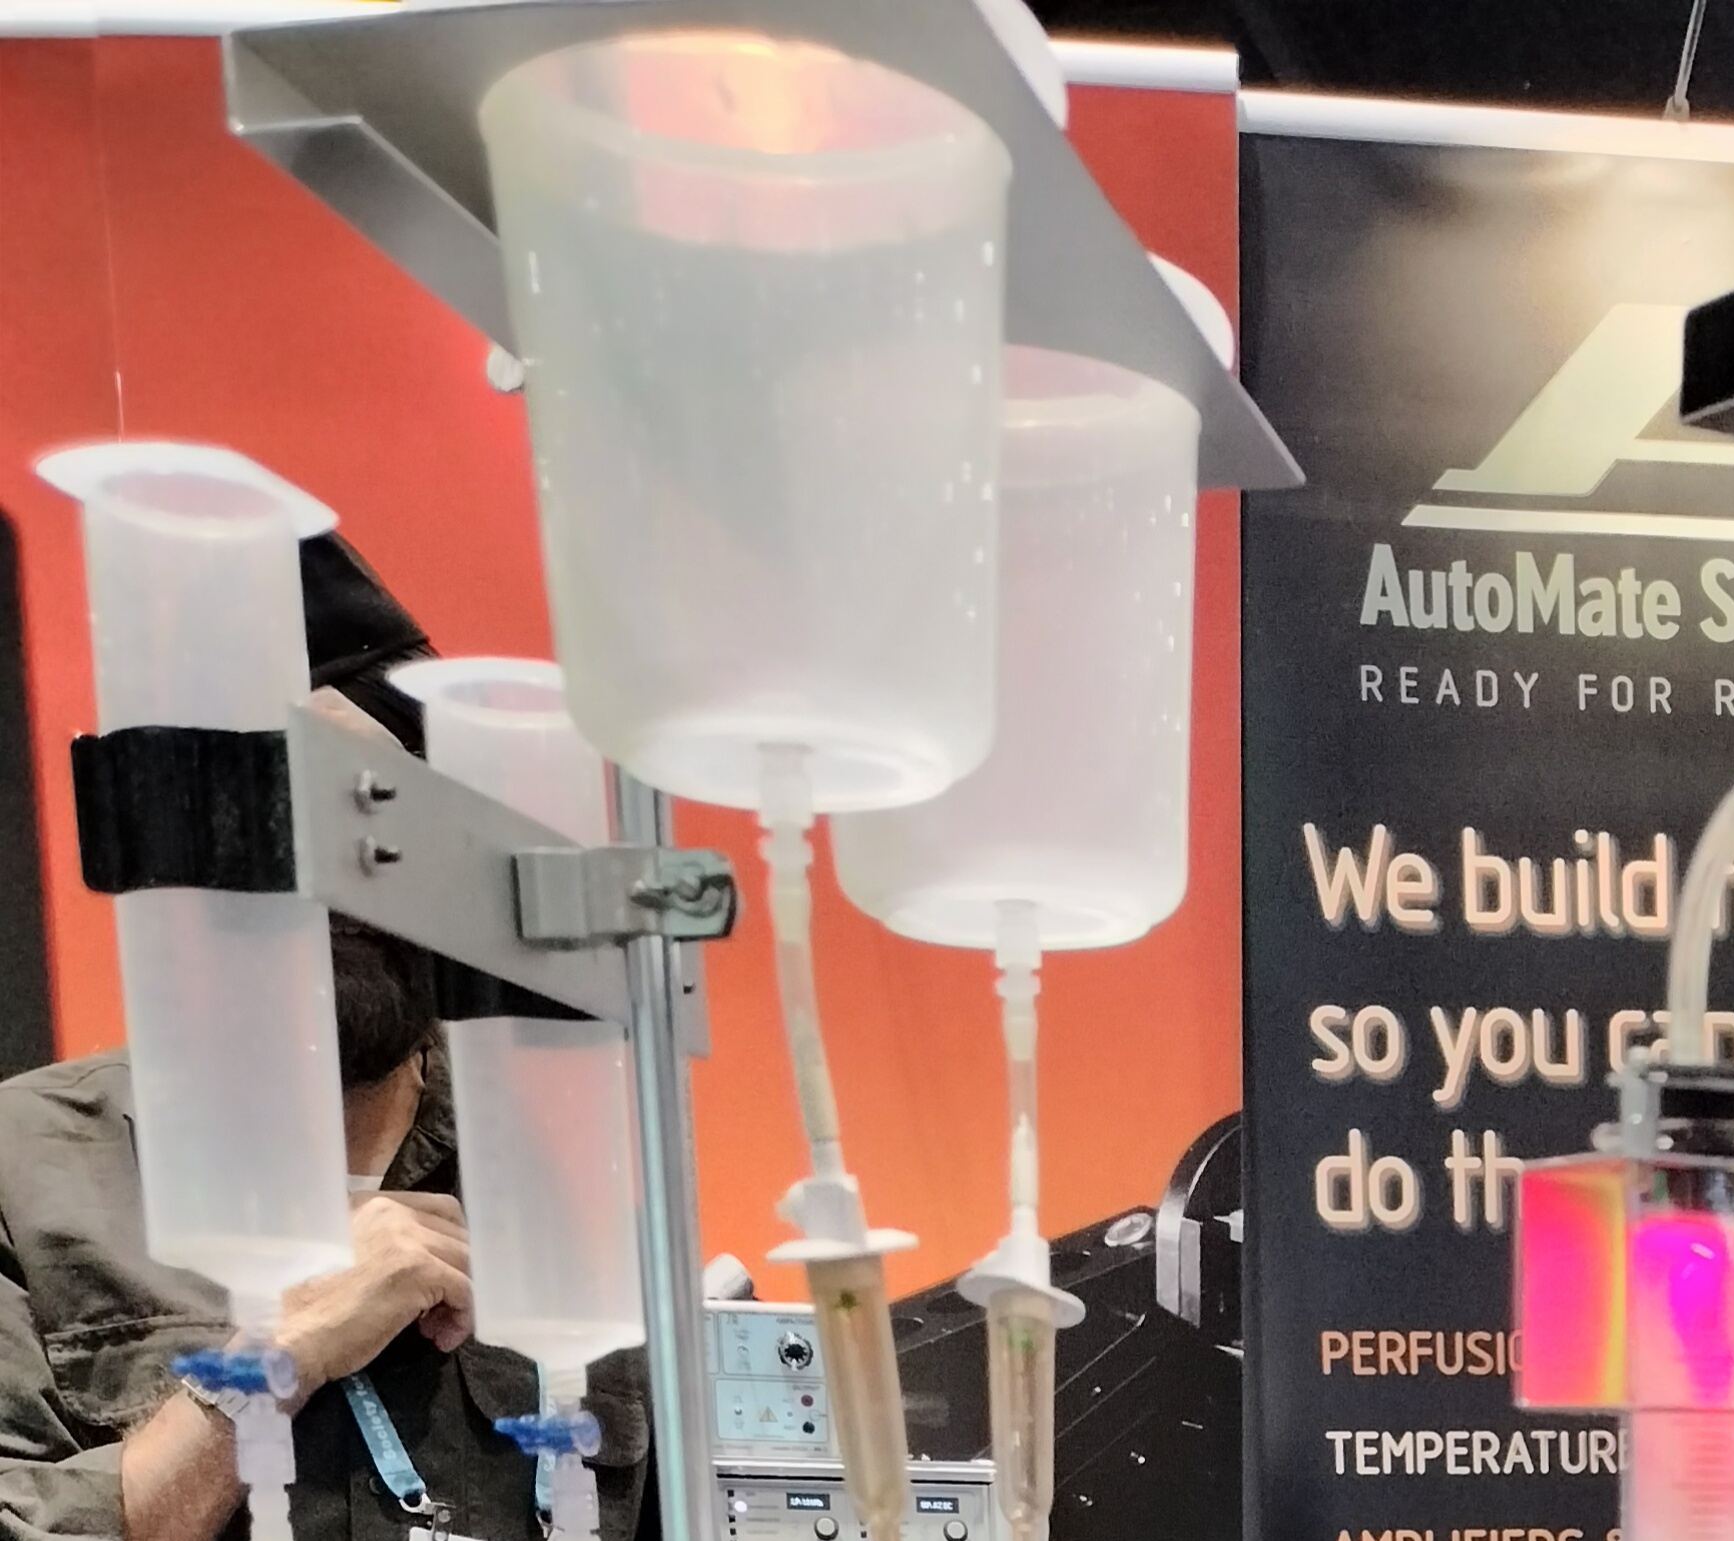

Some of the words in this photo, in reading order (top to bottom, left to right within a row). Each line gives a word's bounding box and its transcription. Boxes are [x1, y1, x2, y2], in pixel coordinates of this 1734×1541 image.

[1360, 543, 1682, 642] AutoMate
[1360, 665, 1540, 708] READY
[1578, 673, 1673, 714] FOR
[1304, 824, 1437, 928] We
[1462, 826, 1672, 934] build
[1310, 1002, 1404, 1080] so
[1431, 1006, 1581, 1108] you
[1315, 1128, 1418, 1228] do
[1444, 1128, 1523, 1228] th
[1322, 1330, 1522, 1376] PERFUSI
